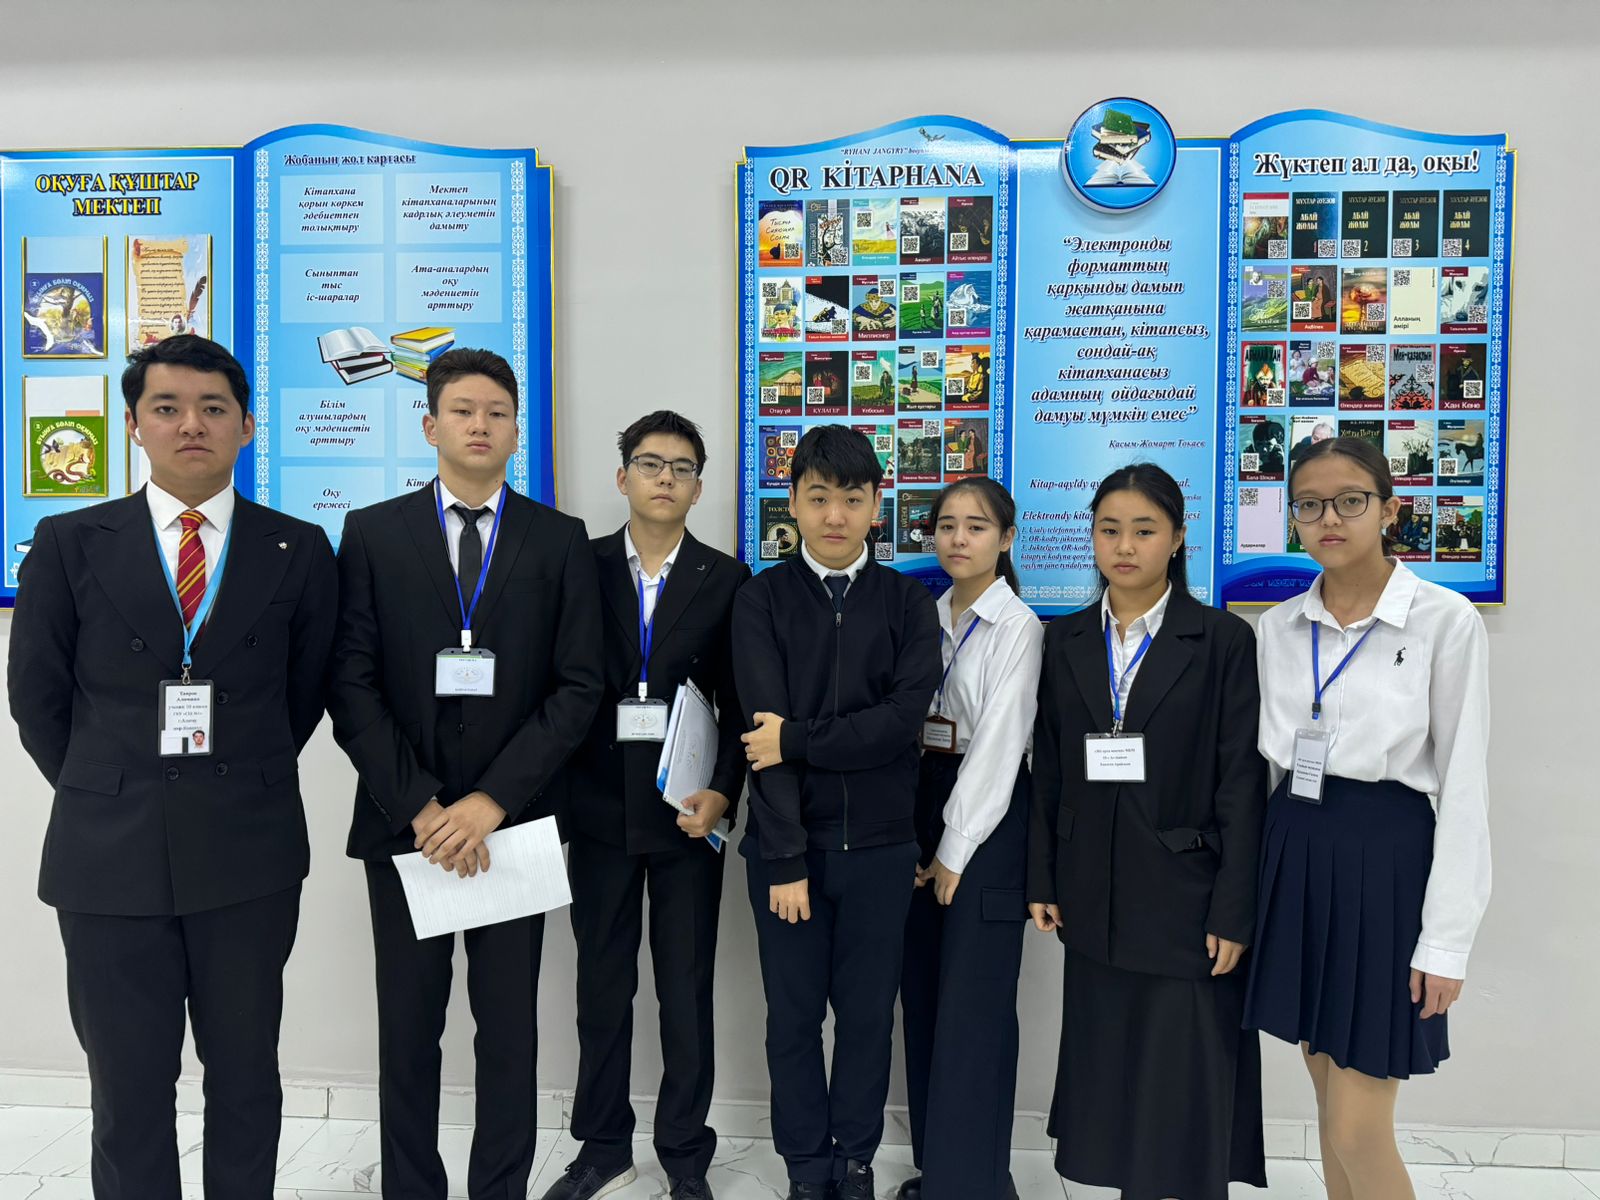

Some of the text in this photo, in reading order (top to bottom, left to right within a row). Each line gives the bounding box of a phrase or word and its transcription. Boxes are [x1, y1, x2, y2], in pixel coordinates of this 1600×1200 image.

[285, 154, 416, 168] Жобаның жол картасы
[1254, 150, 1479, 180] Жүктеп ал да, оқы!
[770, 160, 983, 194] QR KİTAPHANA
[35, 172, 199, 195] ОҚУҒА ҚҰШТАР
[304, 187, 356, 196] Кітапхана
[429, 185, 469, 196] Мектеп
[73, 198, 162, 216] МЕКТЕП
[298, 200, 364, 210] қорын көркем
[401, 196, 497, 208] кітапханаларының
[303, 210, 360, 220] әдебиетпен
[403, 209, 496, 221] кадрлық әлеуметін
[301, 223, 360, 234] толықтыру
[429, 222, 470, 232] дамыту
[1064, 236, 1172, 255] “Электронды
[1363, 240, 1369, 251] 2
[1415, 239, 1420, 251] 3
[1464, 239, 1470, 250] 4
[305, 268, 359, 278] Сыныптан
[411, 265, 489, 275] Ата-аналардың
[1067, 258, 1169, 277] форматтың
[442, 278, 459, 287] оқу
[421, 288, 480, 299] мәдениетін
[1047, 279, 1184, 299] қарқынды дамып
[306, 292, 360, 304] іс-шаралар
[427, 302, 474, 312] арттыру
[1065, 303, 1166, 319] жатқанына
[1024, 322, 1209, 341] қарамастан, кітапсыз,
[1077, 344, 1156, 361] сондай-ақ
[1058, 365, 1169, 381] кітапханасыз
[1031, 388, 1103, 405] адамның
[320, 400, 346, 409] Білім
[299, 412, 367, 422] алушылардың
[1034, 406, 1198, 427] дамуы мүмкін емес”
[295, 424, 370, 434] оқу мәдениетін
[310, 436, 356, 446] арттыру
[323, 489, 341, 499] Оқу
[313, 500, 351, 510] ережесі
[1022, 511, 1071, 522] Elektrondy
